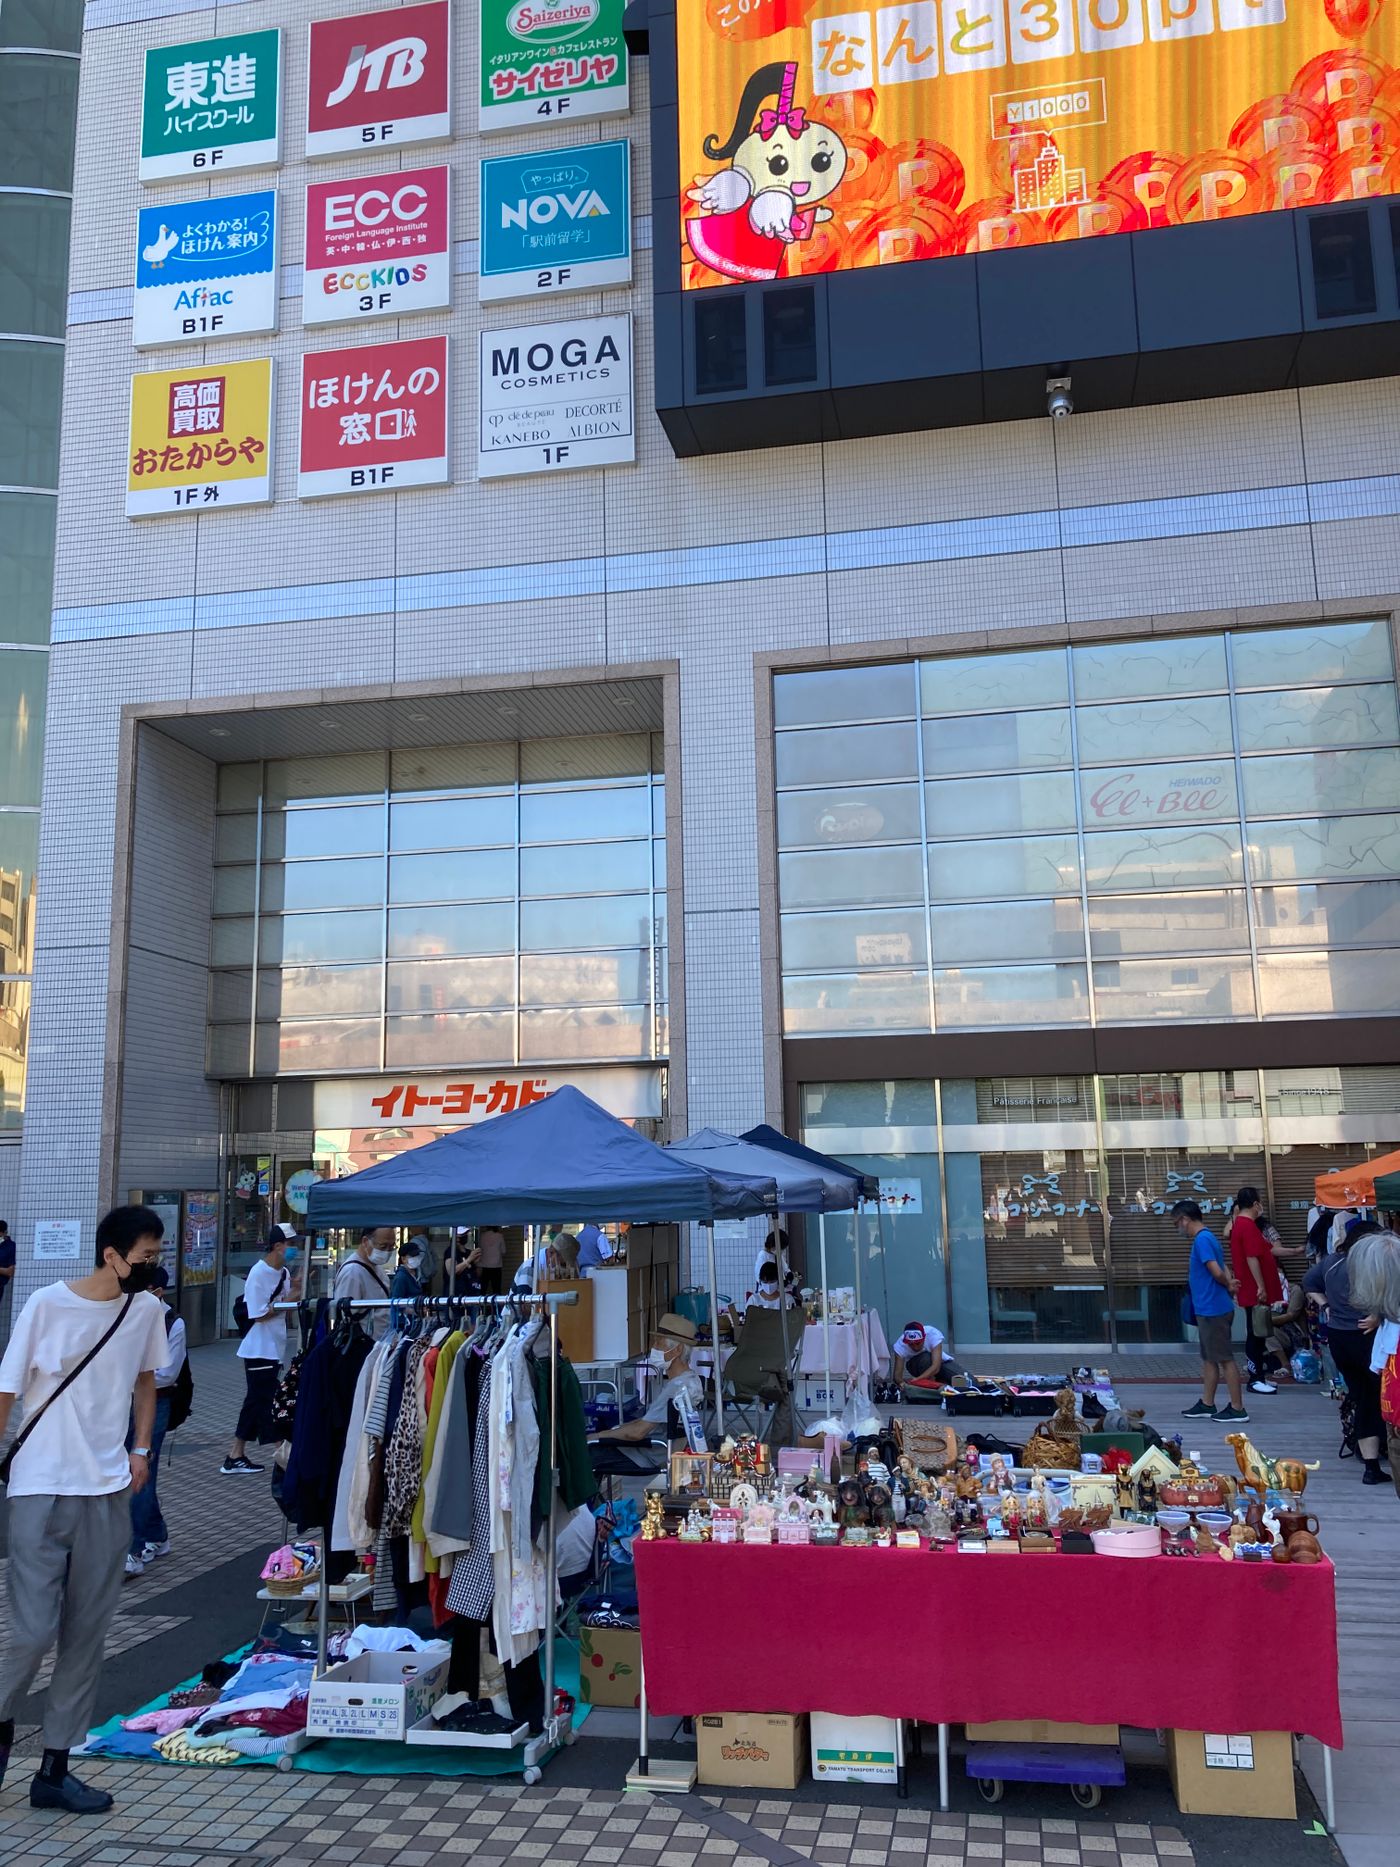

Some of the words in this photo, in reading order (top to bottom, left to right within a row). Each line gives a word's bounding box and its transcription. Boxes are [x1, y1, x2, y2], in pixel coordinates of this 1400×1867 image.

[515, 5, 590, 34] Saizeriya
[819, 0, 1262, 76] なんと30p
[164, 52, 256, 112] 東進
[326, 36, 428, 108] JTB
[491, 56, 616, 97] サイゼリヤ
[537, 98, 570, 116] 4F
[163, 105, 255, 136] ハイスクール
[362, 124, 393, 143] 5F
[192, 150, 223, 168] 6F
[325, 184, 428, 231] ECC
[501, 189, 611, 231] NOVA
[182, 217, 248, 238] よくわかる!
[325, 231, 354, 242] Foreign
[356, 226, 394, 239] Language
[396, 222, 428, 232] Institute
[522, 229, 590, 248] 「駅前留学」
[181, 231, 258, 254] ほけん案内
[537, 269, 571, 288] 2F
[173, 287, 234, 311] Aflac
[359, 293, 391, 311] 3F
[182, 315, 224, 334] B1F
[492, 335, 621, 377] MOGA
[309, 366, 440, 409] ほけんの
[501, 368, 610, 390] COSMETICS
[173, 381, 221, 409] 高価
[172, 407, 220, 434] 買取
[338, 408, 404, 446] 窓口
[568, 421, 621, 438] ALBION
[492, 430, 551, 445] KANEBO
[132, 436, 265, 476] おたからや
[543, 446, 569, 464] 1F
[350, 467, 394, 487] B1F
